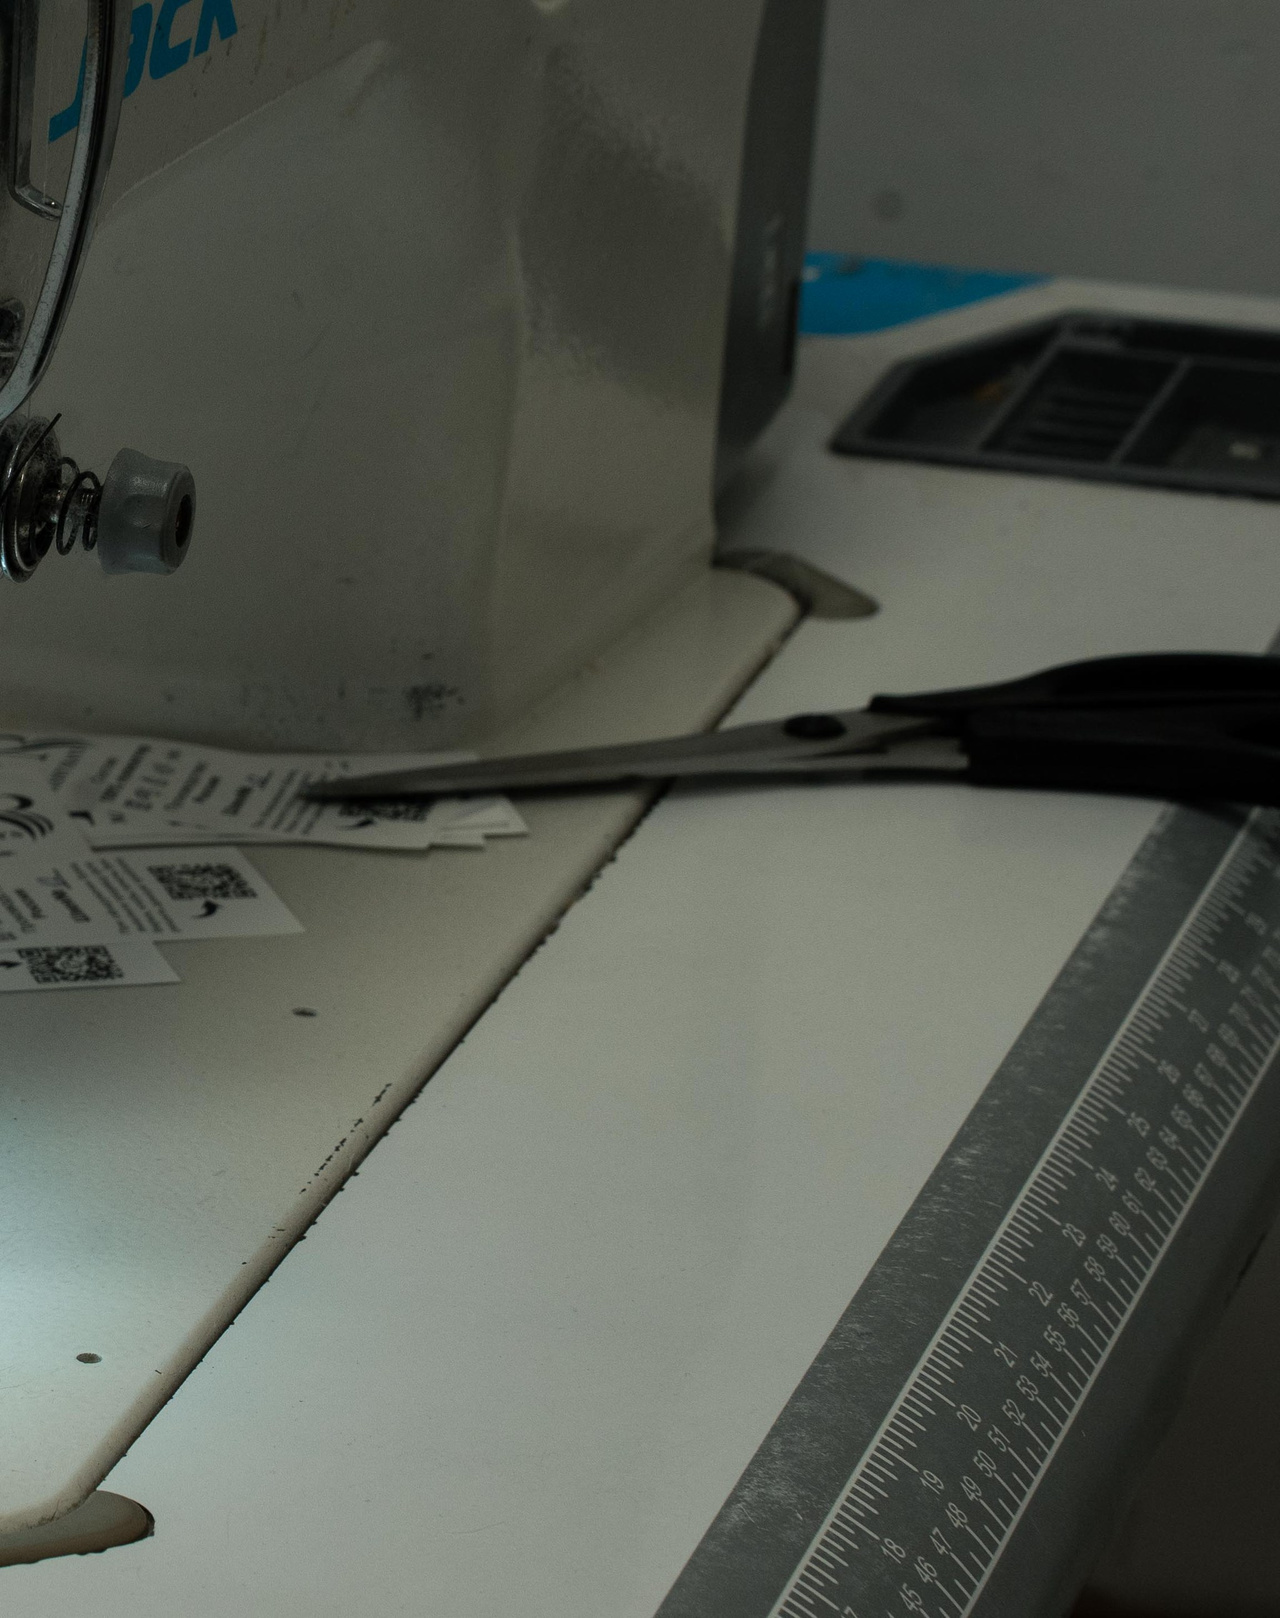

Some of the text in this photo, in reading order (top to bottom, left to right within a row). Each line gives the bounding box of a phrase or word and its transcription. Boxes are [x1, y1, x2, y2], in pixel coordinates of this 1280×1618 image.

[880, 1537, 907, 1565] 18
[919, 1469, 945, 1495] 19
[956, 1404, 982, 1431] 20
[993, 1340, 1019, 1368] 21
[1028, 1281, 1054, 1307] 22
[1062, 1222, 1087, 1247] 23
[1095, 1166, 1119, 1191] 24
[898, 1582, 923, 1611] 45
[913, 1556, 938, 1584] 46
[929, 1526, 952, 1555] 47
[944, 1502, 968, 1529] 48
[960, 1475, 982, 1502] 49
[973, 1450, 997, 1478] 50
[987, 1424, 1011, 1452] 51
[1001, 1398, 1026, 1426] 52
[1016, 1374, 1039, 1401] 53
[1030, 1350, 1053, 1378] 54
[1043, 1324, 1067, 1352] 55
[1057, 1302, 1080, 1328] 56
[1070, 1278, 1091, 1306] 57
[1083, 1255, 1106, 1282] 58
[1096, 1233, 1118, 1259] 59
[1108, 1211, 1131, 1236] 60
[1122, 1189, 1144, 1215] 61
[1134, 1166, 1156, 1192] 62
